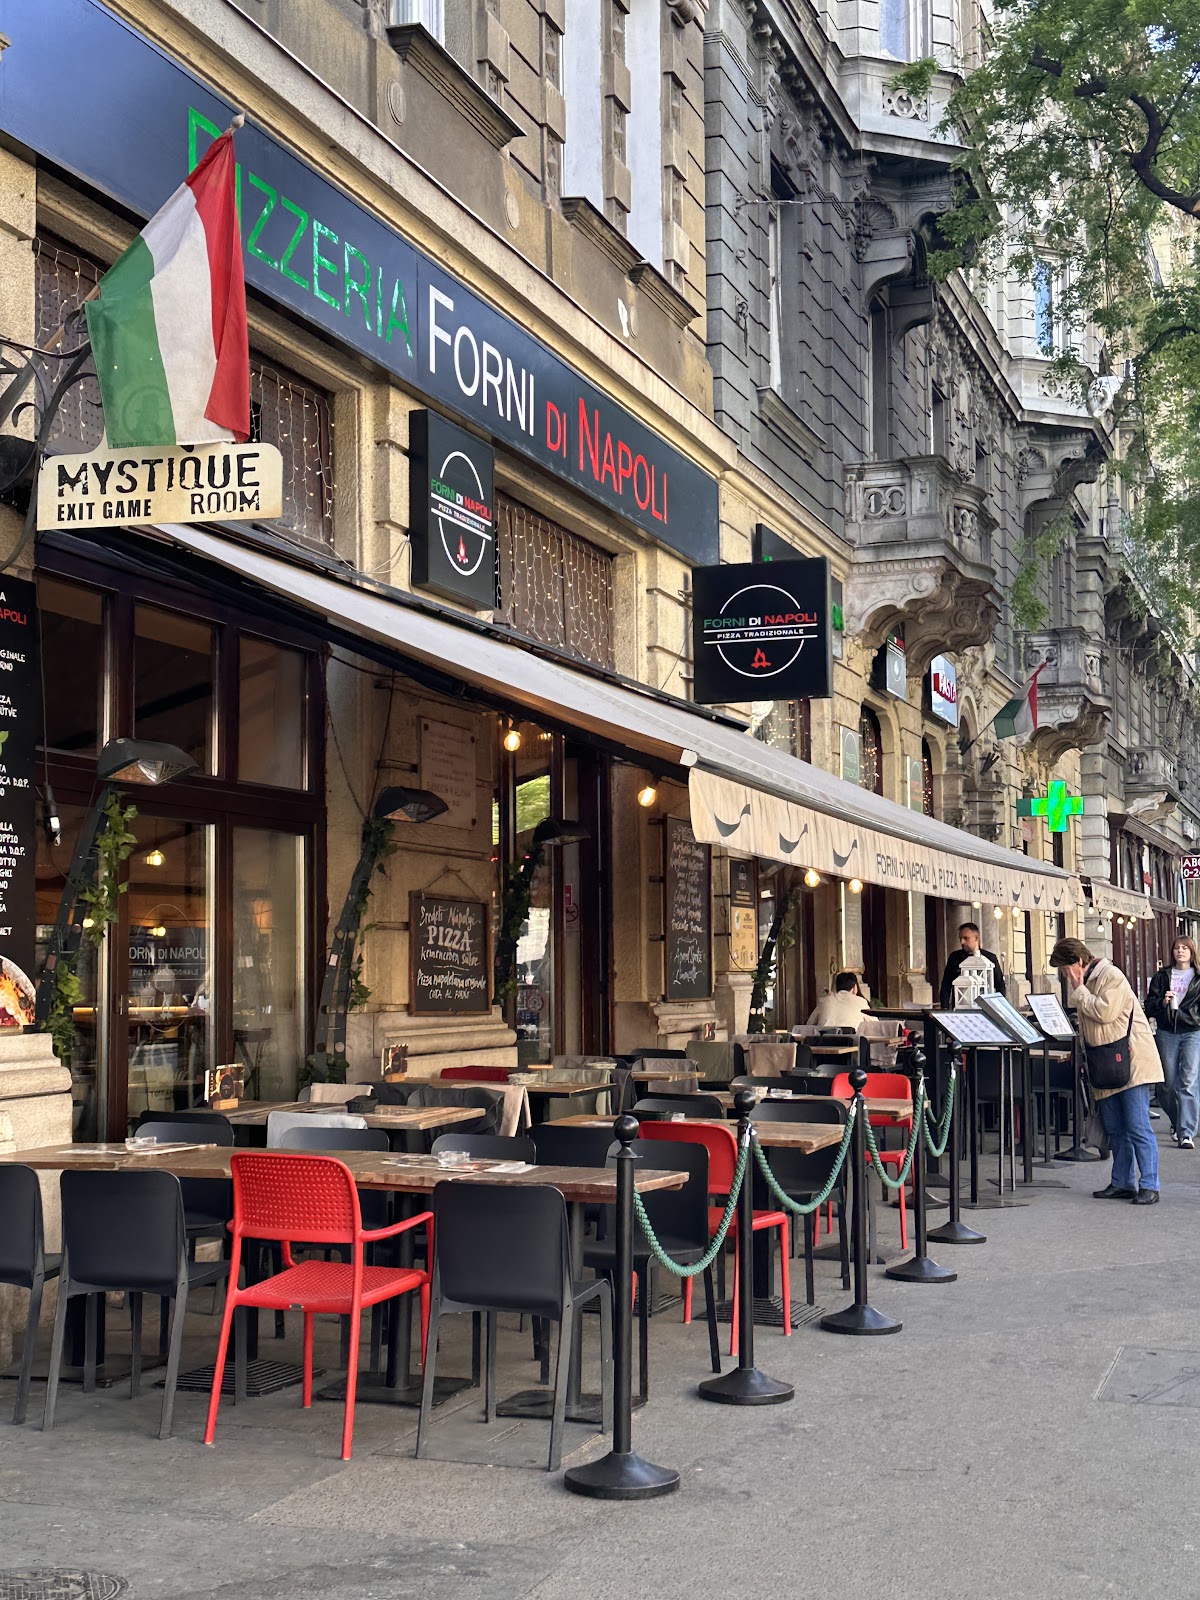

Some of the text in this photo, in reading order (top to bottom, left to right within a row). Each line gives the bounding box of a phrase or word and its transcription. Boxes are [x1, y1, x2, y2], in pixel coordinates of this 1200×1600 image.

[429, 284, 535, 436] FORNI
[546, 400, 567, 459] DI
[578, 397, 668, 525] NAPOLI
[57, 453, 260, 498] MYSTIQUE
[57, 489, 260, 522] EXIT GAME ROOM
[431, 479, 493, 521] FORNI DI NAPOLI
[703, 616, 746, 629] FORNI
[748, 616, 762, 627] DI
[764, 611, 818, 625] NAPOLI
[716, 628, 805, 640] PIZZA TRADIZIONALE
[876, 853, 898, 878] FORNI
[906, 860, 930, 884] NAPOLI
[939, 868, 959, 890] PIZZA
[1183, 868, 1200, 878] 0-2
[427, 925, 473, 951] PIZZA
[129, 946, 155, 960] ORN
[158, 948, 168, 960] DI
